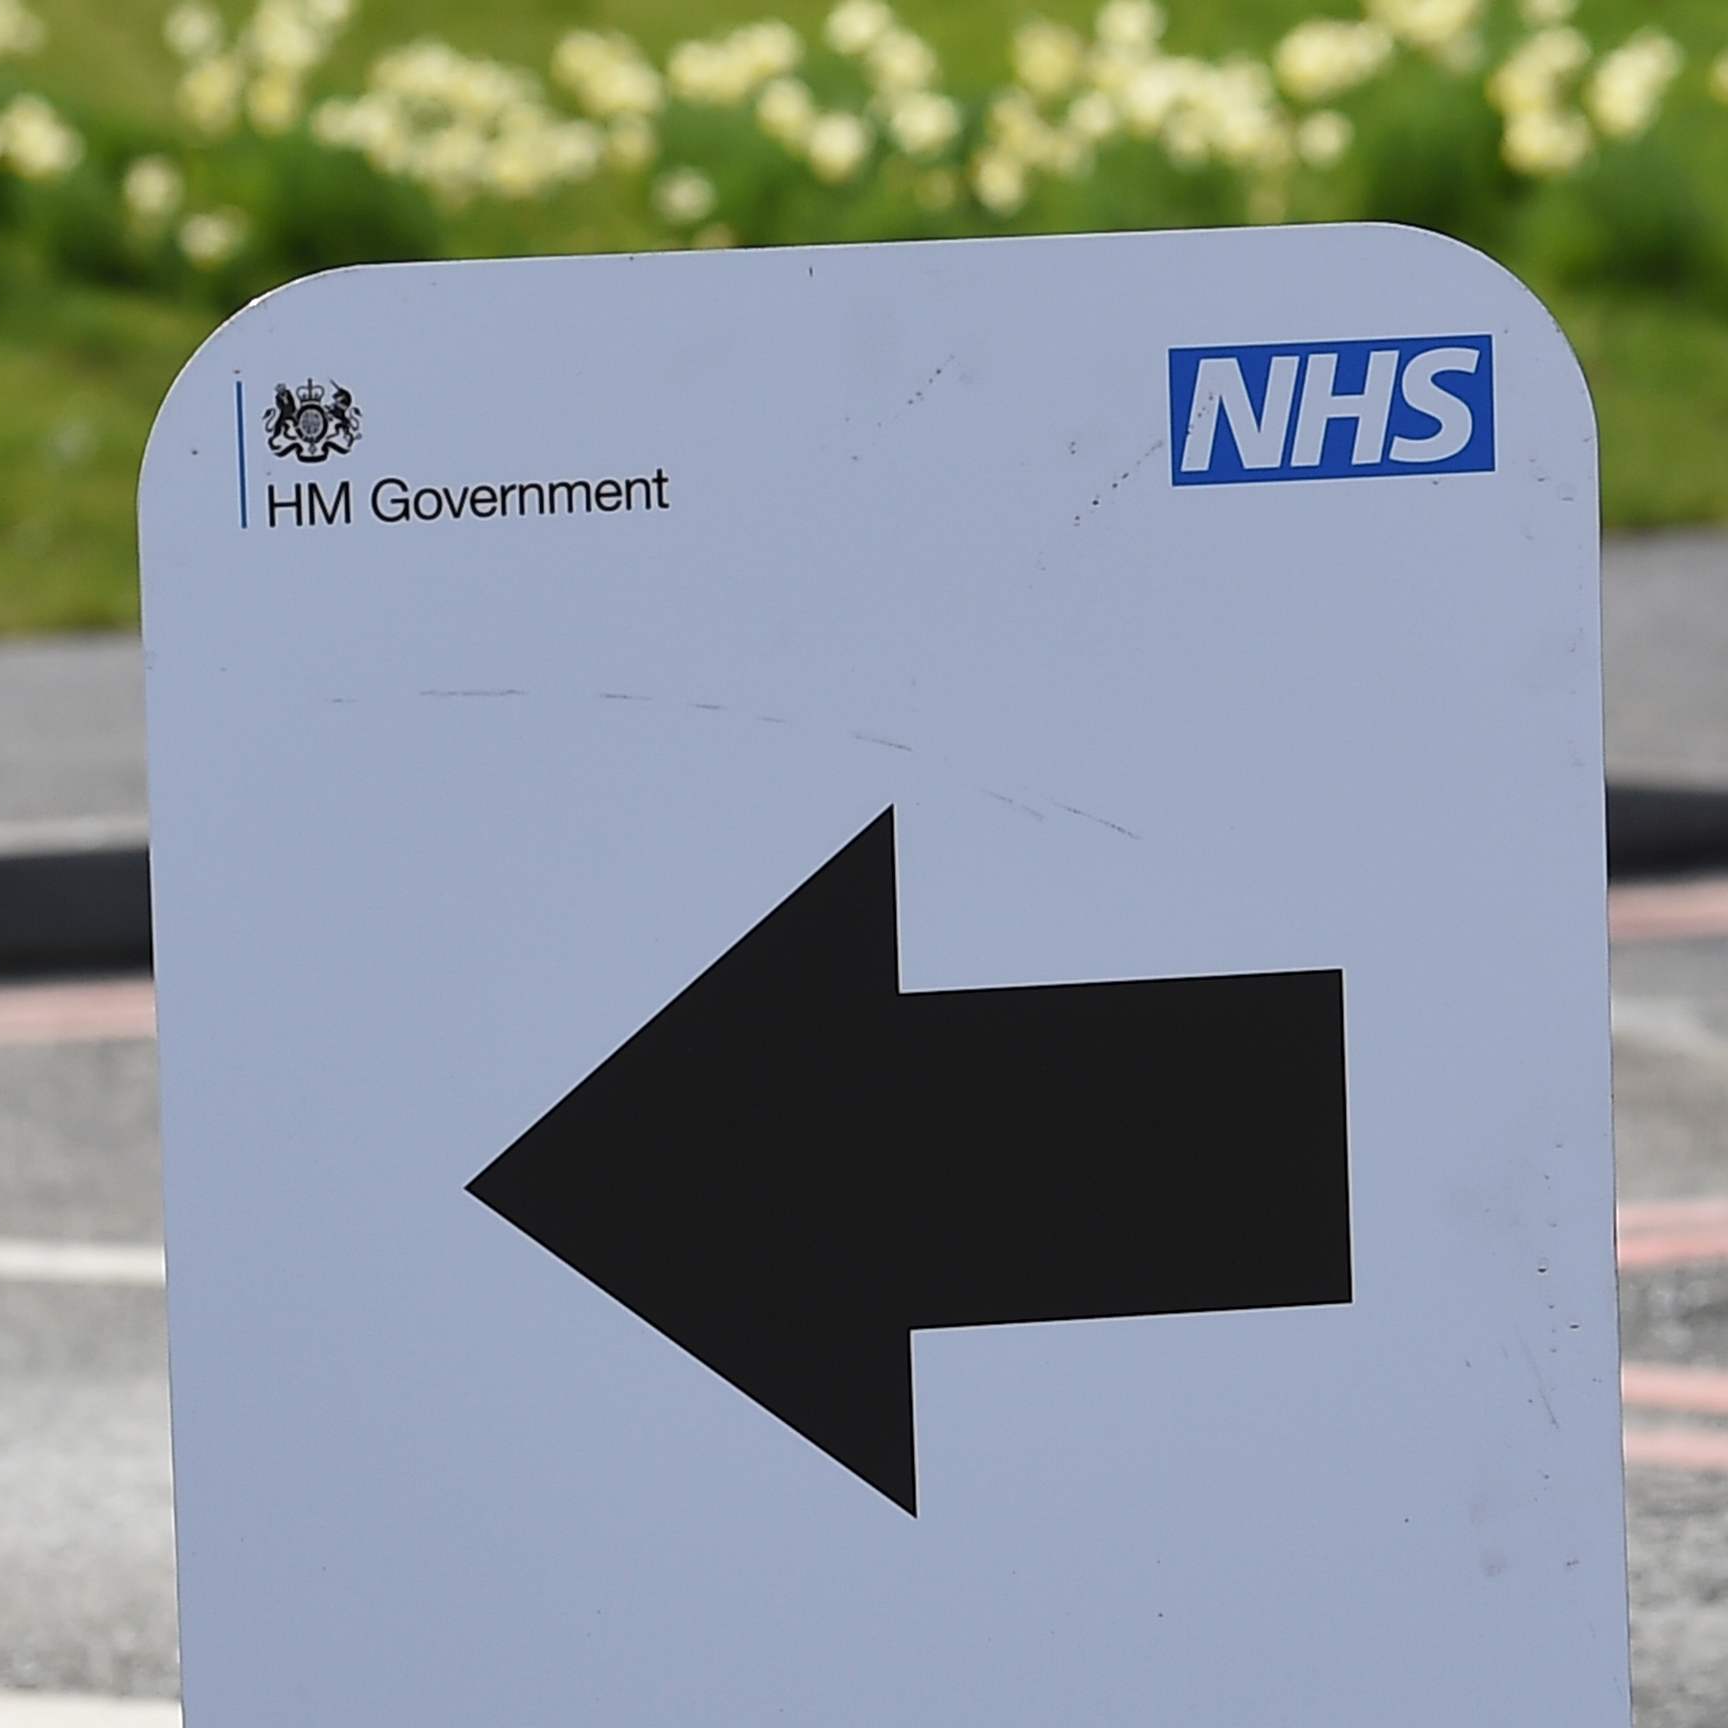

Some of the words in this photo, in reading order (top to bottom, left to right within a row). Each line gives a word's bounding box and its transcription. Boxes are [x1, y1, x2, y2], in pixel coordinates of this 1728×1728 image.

[1180, 346, 1480, 473] NHS
[266, 479, 352, 528] HM
[370, 467, 671, 524] Government
